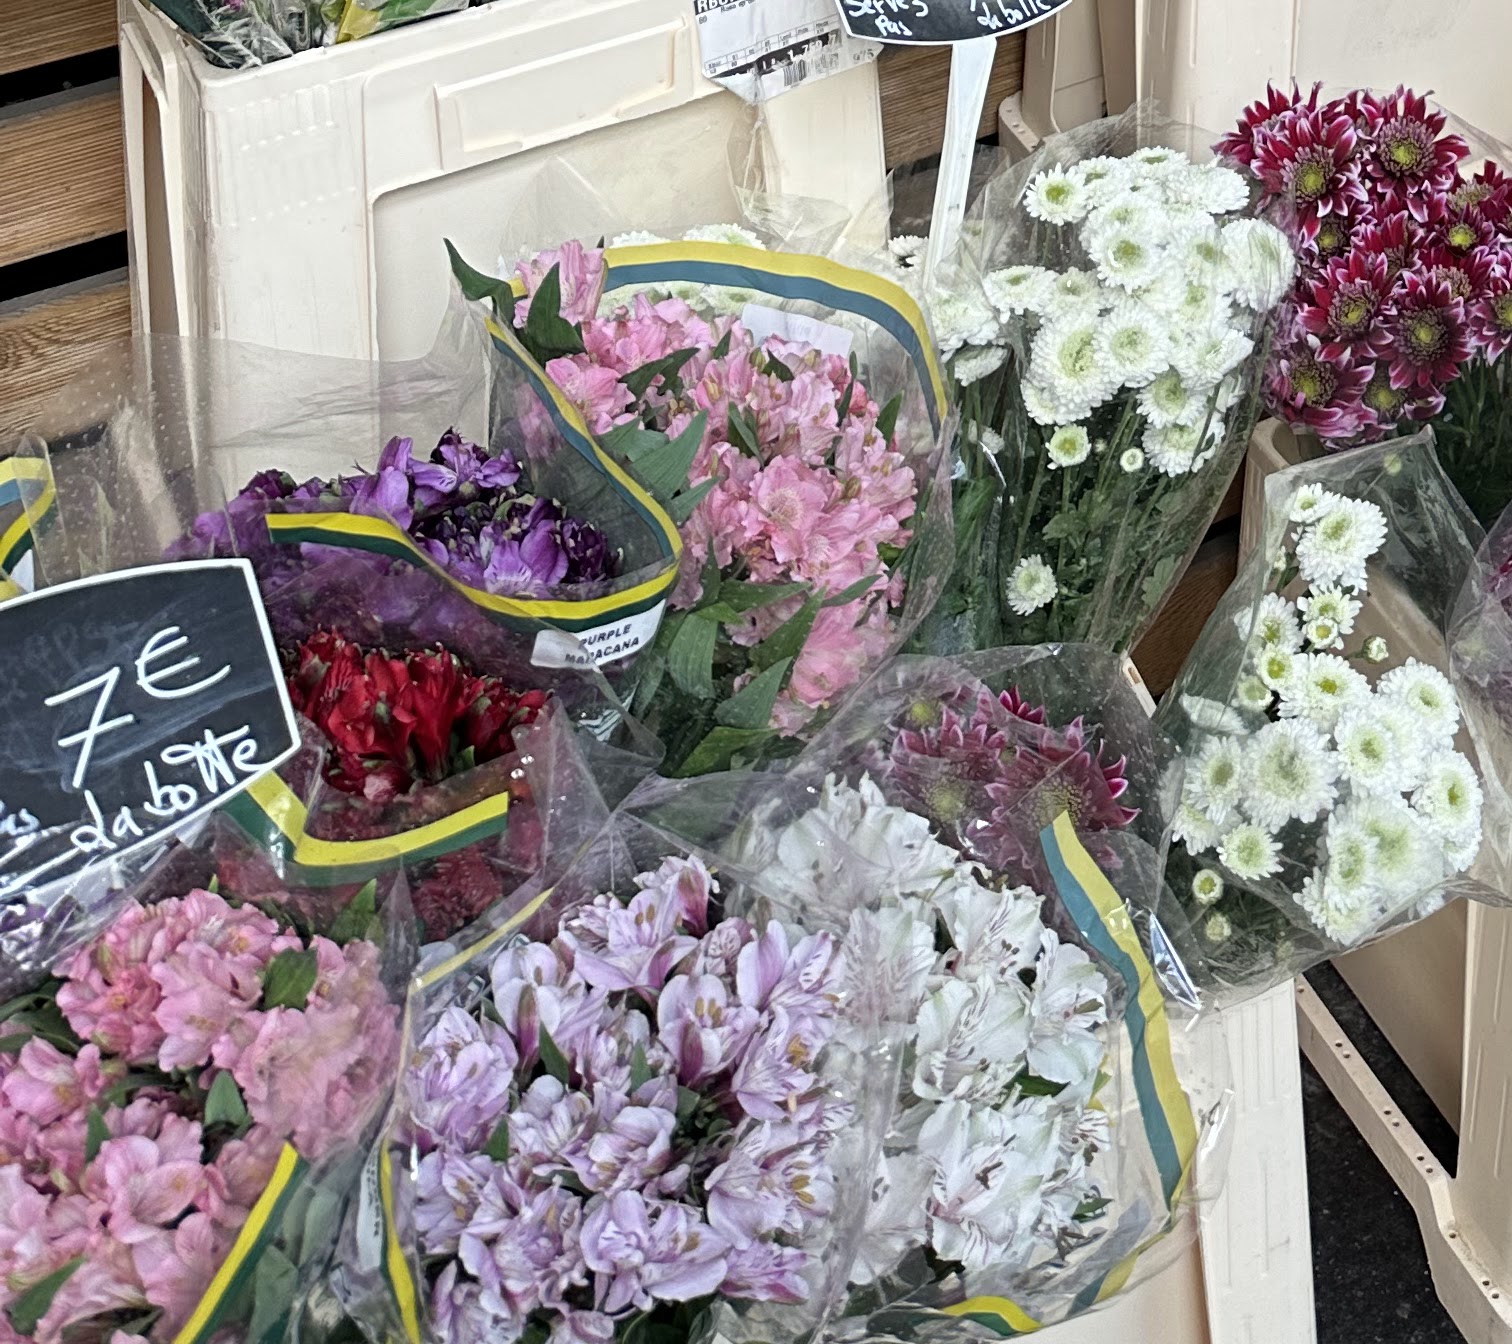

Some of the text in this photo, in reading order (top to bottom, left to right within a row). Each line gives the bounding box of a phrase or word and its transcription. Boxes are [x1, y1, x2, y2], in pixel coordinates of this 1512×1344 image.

[580, 624, 632, 649] PURPLE
[44, 626, 231, 788] 7 €
